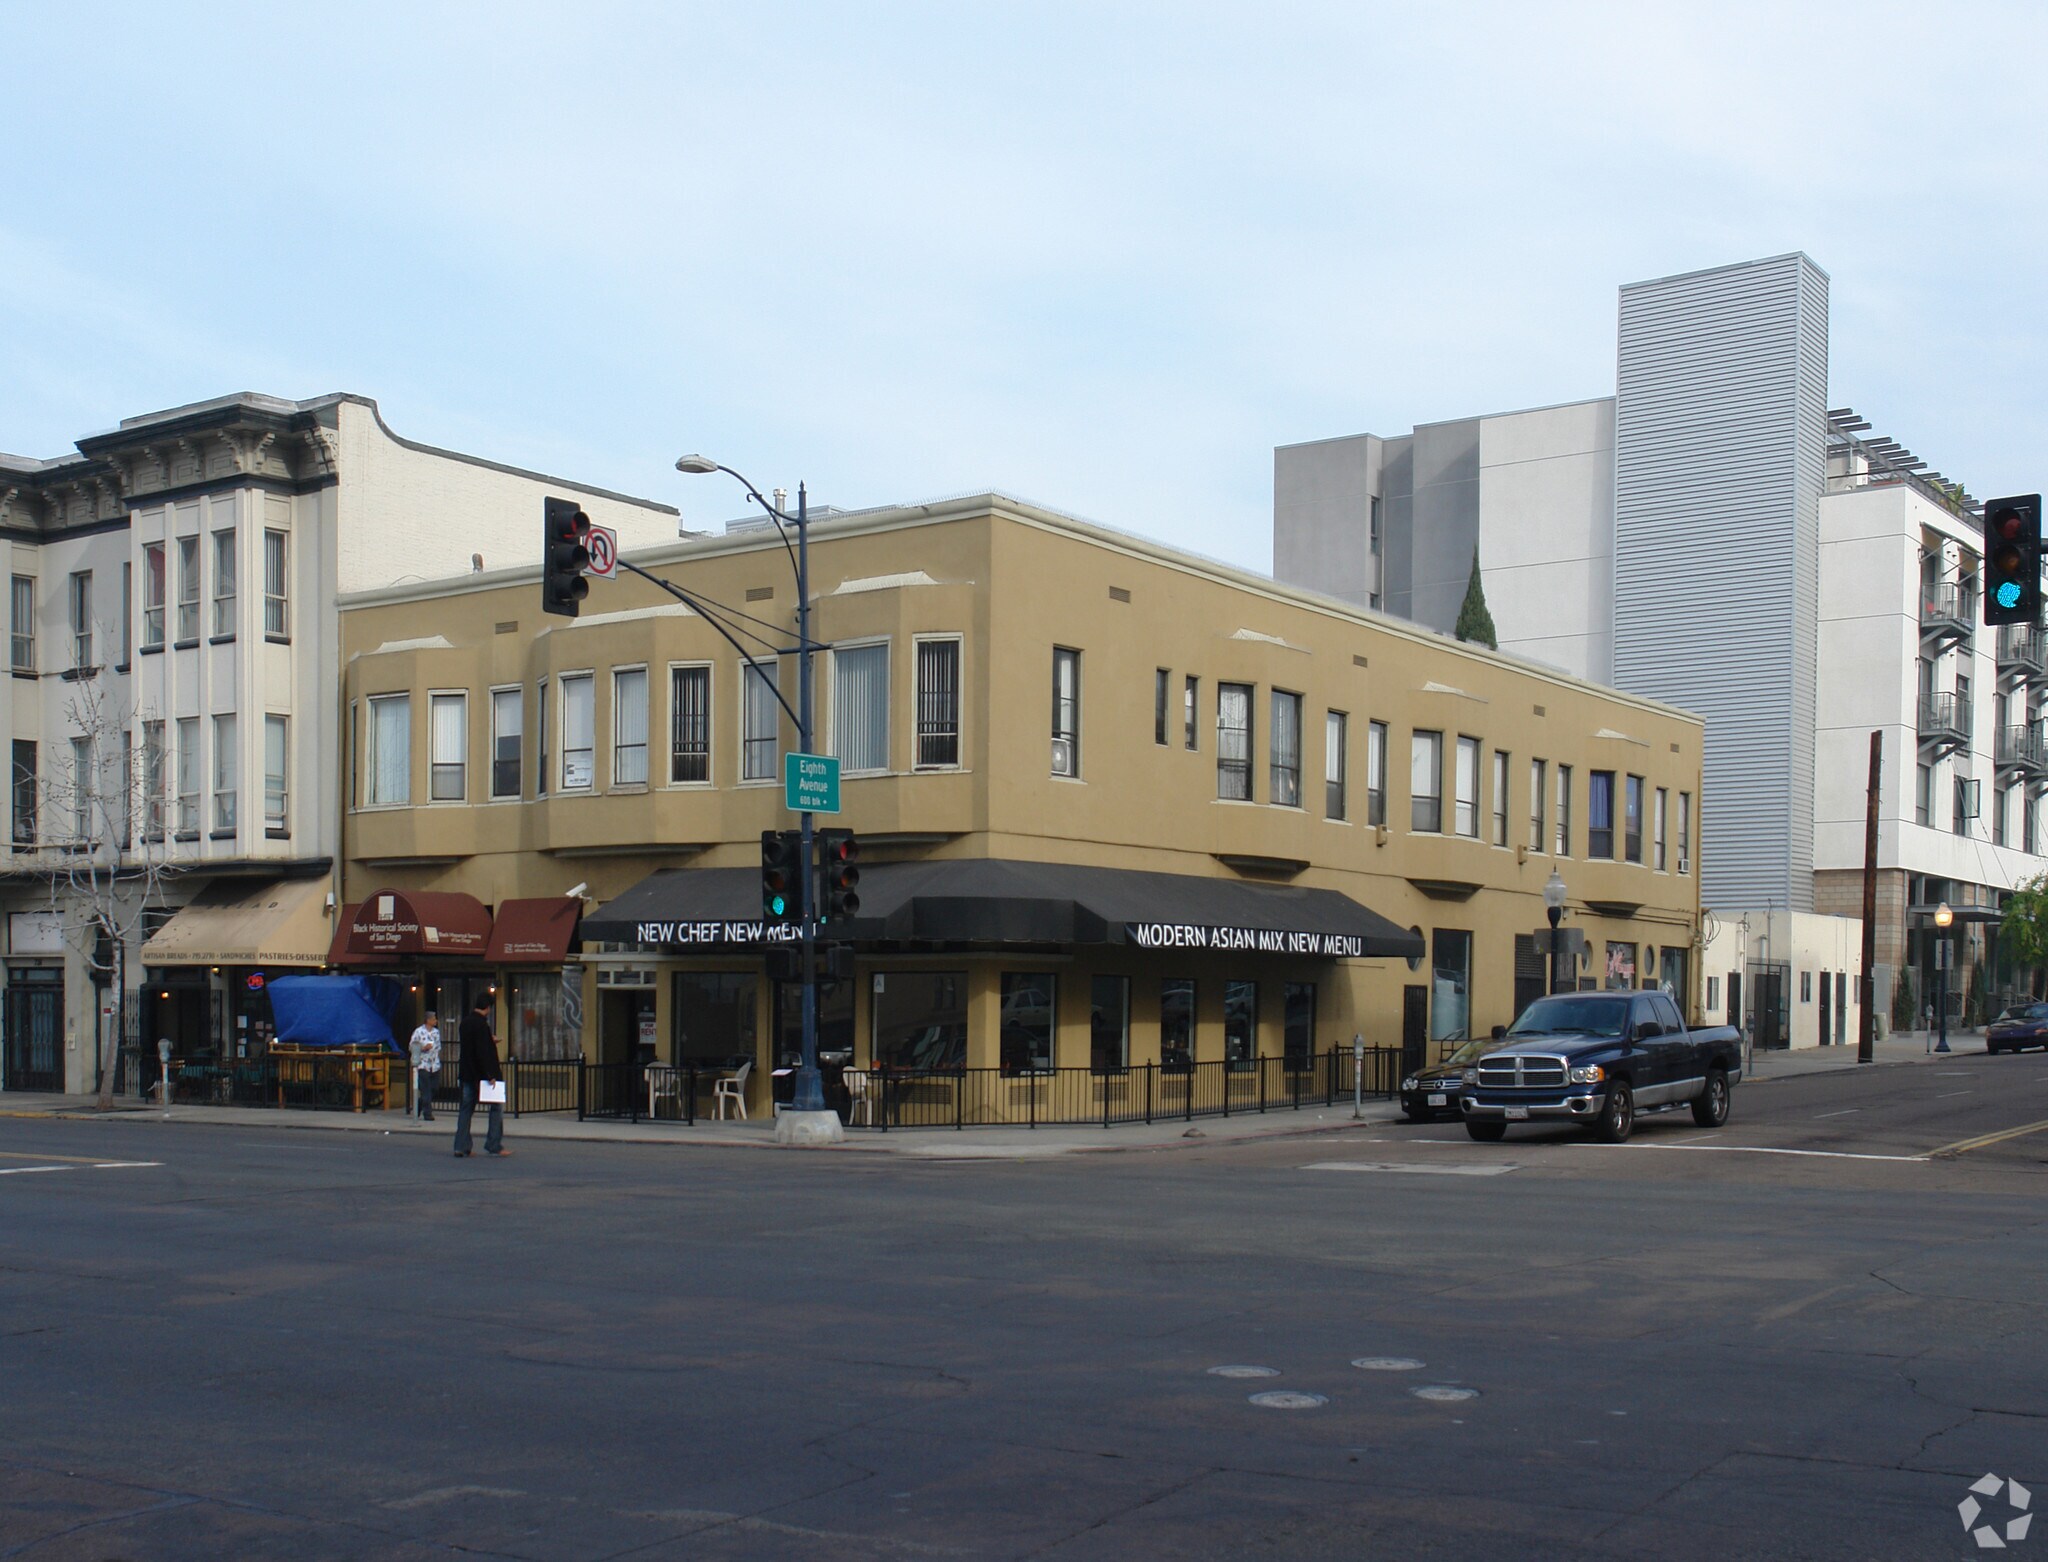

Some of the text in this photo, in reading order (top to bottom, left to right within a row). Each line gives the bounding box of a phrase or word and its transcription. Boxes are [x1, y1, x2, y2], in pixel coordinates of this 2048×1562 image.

[800, 760, 827, 778] Eighth
[799, 777, 828, 792] Avenue
[353, 922, 419, 934] Black Historical Society
[637, 923, 674, 942] NEW
[678, 922, 721, 942] CHEF
[724, 922, 763, 942] NEW
[369, 933, 402, 943] of San Diego
[1137, 923, 1362, 955] MODERN ASIAN MIX NEW MENU
[144, 952, 165, 960] ARTISAN
[166, 952, 188, 960] BREADS
[220, 952, 256, 960] SANDWICHES
